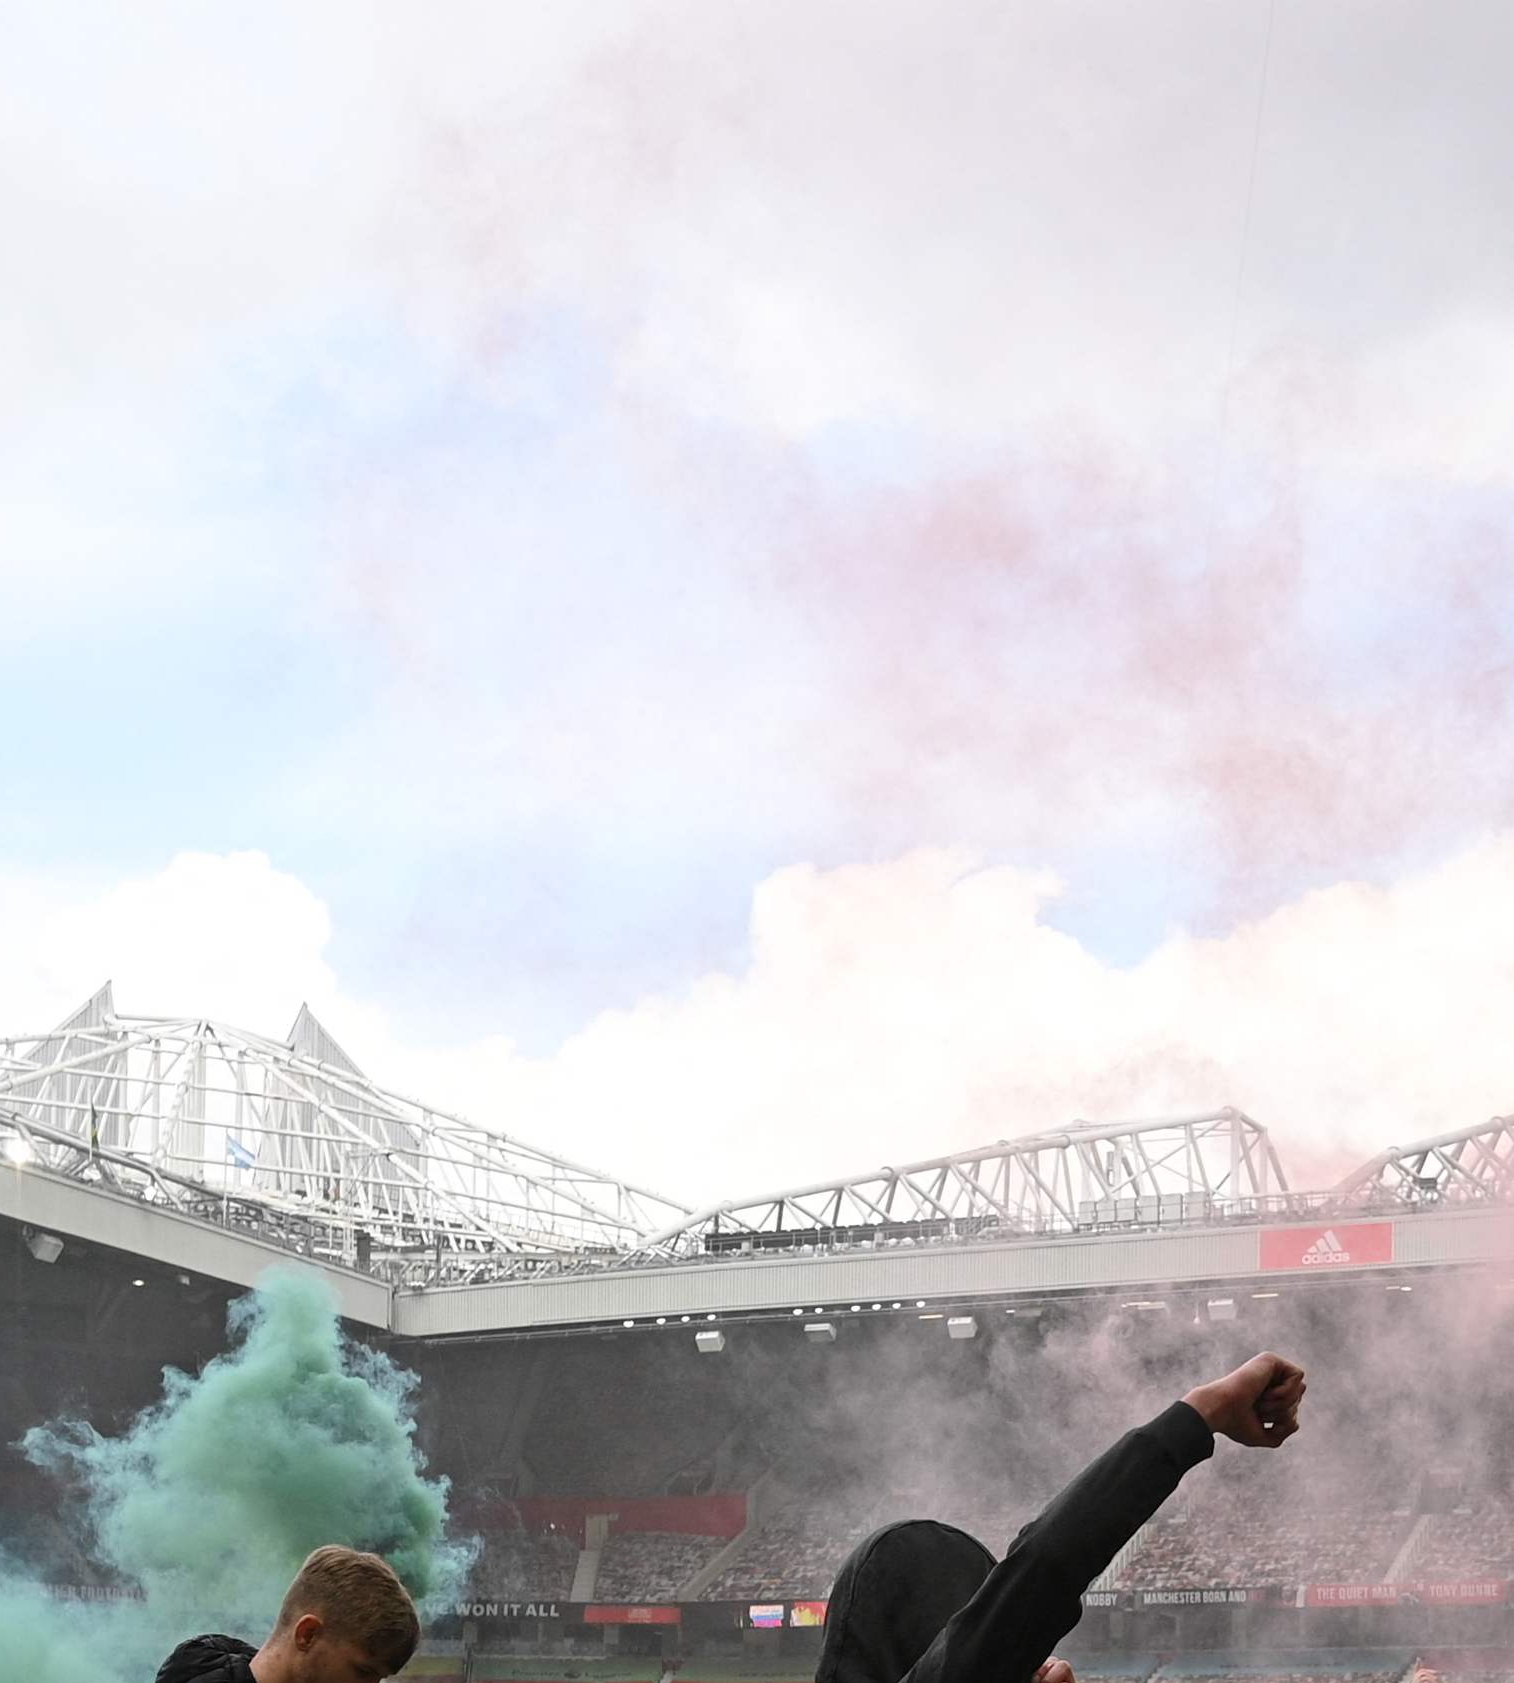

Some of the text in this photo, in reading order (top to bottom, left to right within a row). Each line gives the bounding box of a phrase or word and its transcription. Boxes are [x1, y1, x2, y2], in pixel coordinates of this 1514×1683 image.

[1301, 1252, 1350, 1265] adidas
[1143, 1593, 1201, 1604] MANCHESTER
[1202, 1592, 1226, 1603] BORN
[1228, 1591, 1246, 1602] AND
[455, 1603, 498, 1617] WON
[503, 1604, 521, 1617] IT
[525, 1604, 560, 1617] ALL
